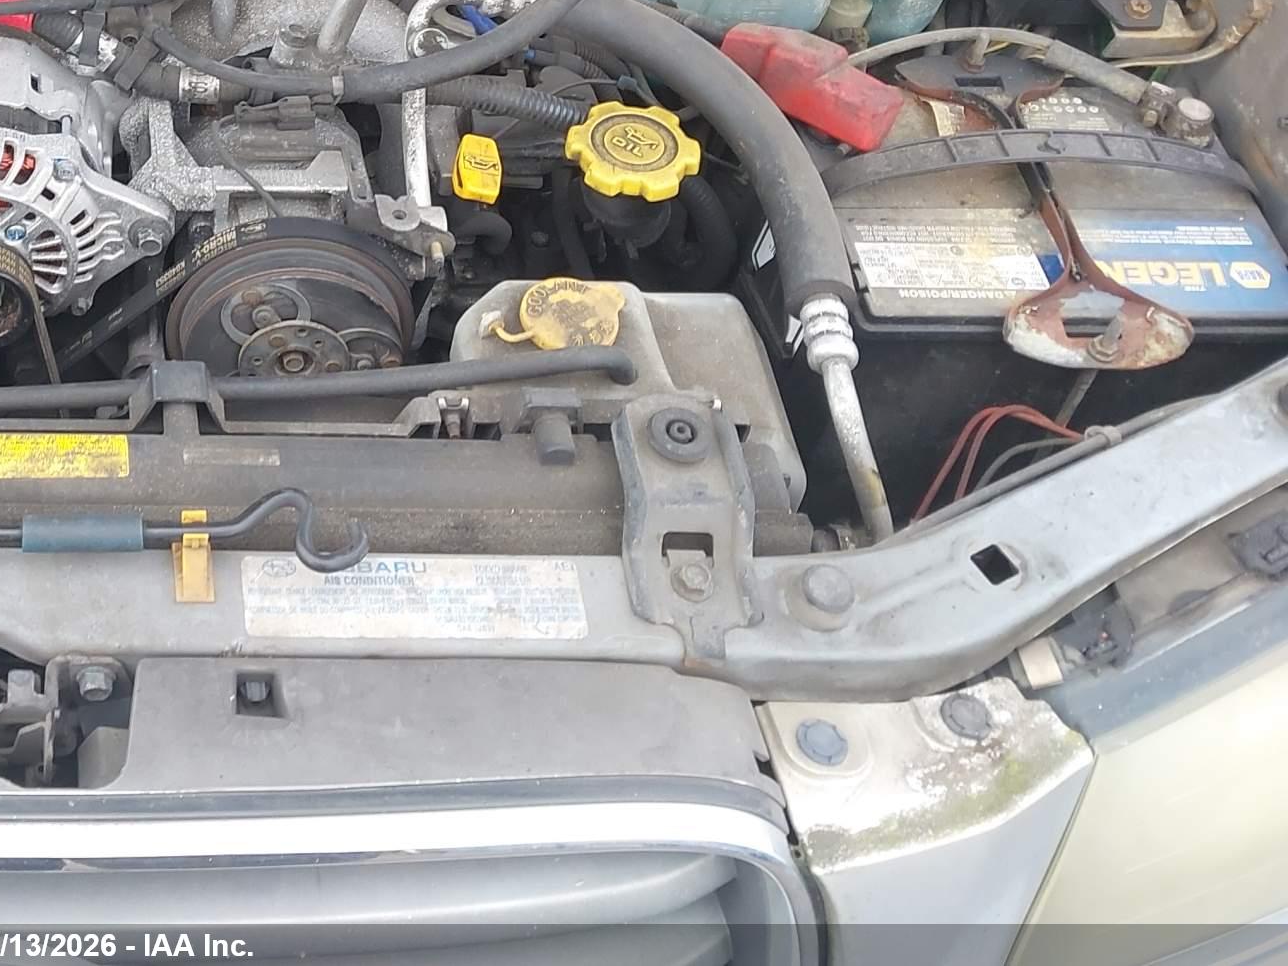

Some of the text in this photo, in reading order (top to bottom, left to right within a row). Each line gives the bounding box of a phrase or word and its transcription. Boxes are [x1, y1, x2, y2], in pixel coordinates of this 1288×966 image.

[612, 135, 644, 158] OIL
[1096, 260, 1225, 287] LEGEN
[898, 288, 1004, 299] DANGER/POISON
[344, 575, 415, 586] CONDITIONER
